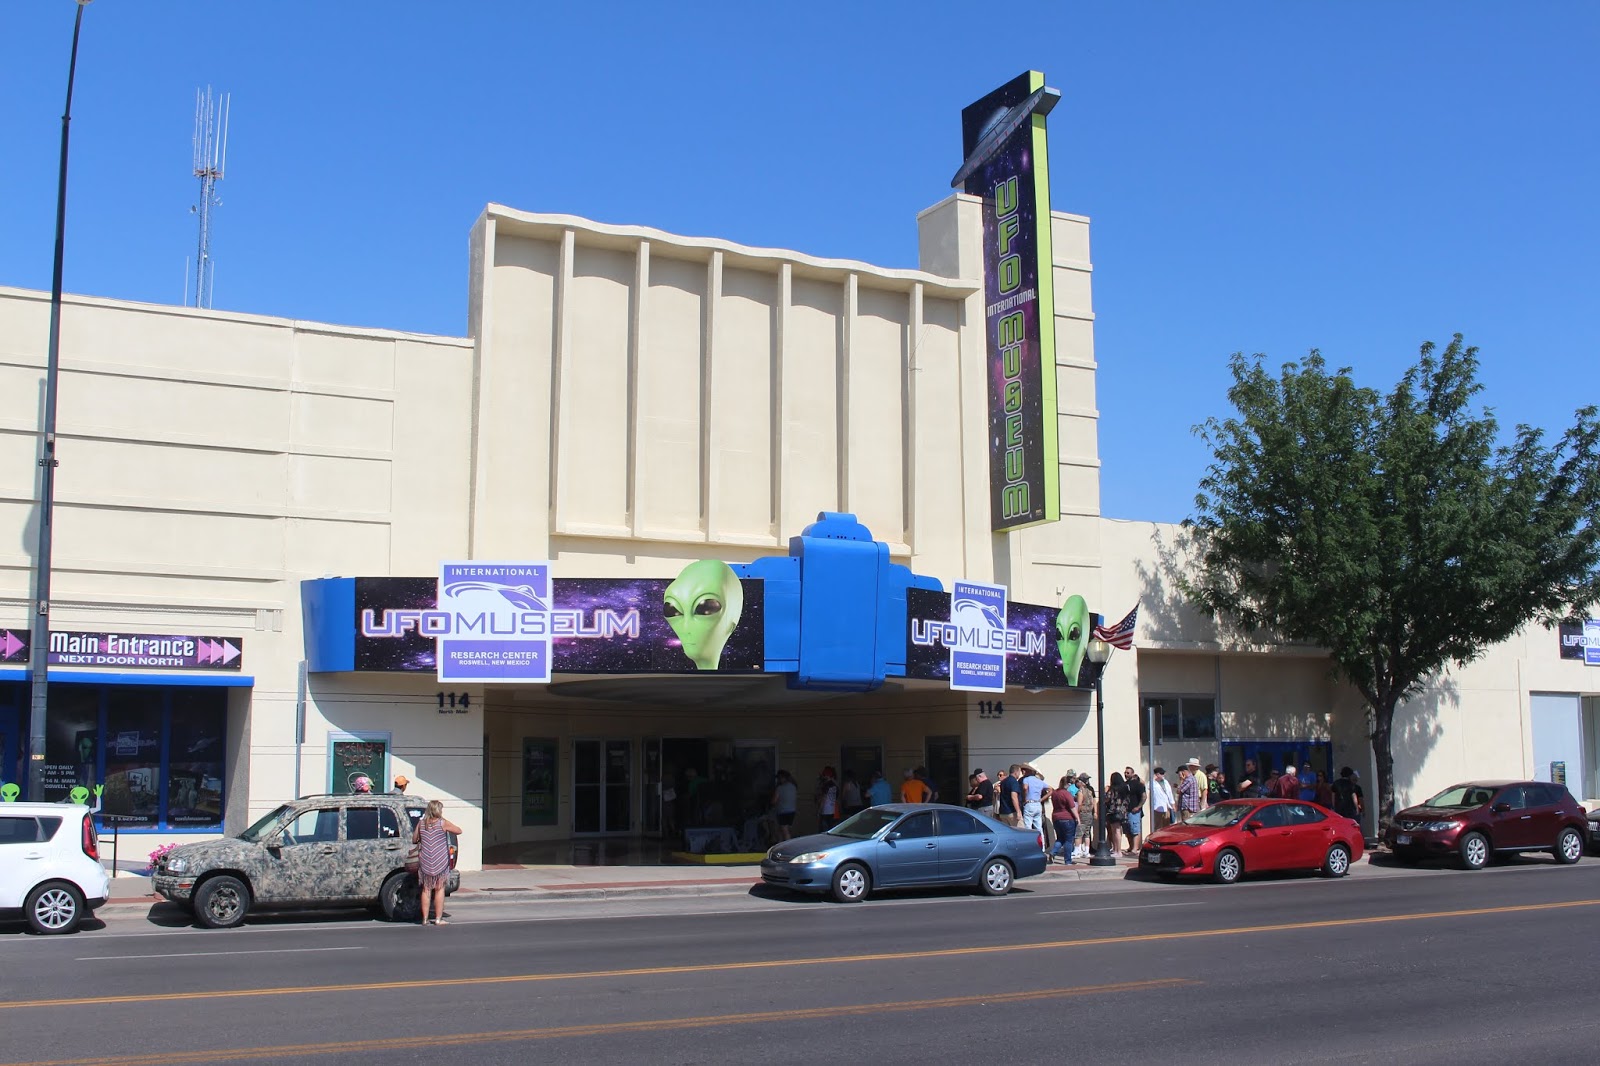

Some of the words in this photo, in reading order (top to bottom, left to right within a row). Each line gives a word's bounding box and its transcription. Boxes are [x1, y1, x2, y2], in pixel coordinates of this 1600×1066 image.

[986, 288, 1037, 317] INTERNATIONAL
[451, 568, 540, 576] INTERNATIONAL
[958, 586, 1002, 599] INTERNATIONAL
[50, 632, 98, 654] Main
[107, 634, 194, 657] Entrance
[59, 655, 94, 664] NEXT
[96, 656, 135, 665] DOOR
[138, 657, 184, 666] NORTH
[450, 651, 500, 659] RESEARCH
[502, 651, 538, 659] CENTER
[956, 661, 981, 670] RESEARCH
[981, 664, 1000, 672] CENTER
[436, 691, 470, 708] 114
[978, 700, 1004, 714] 114
